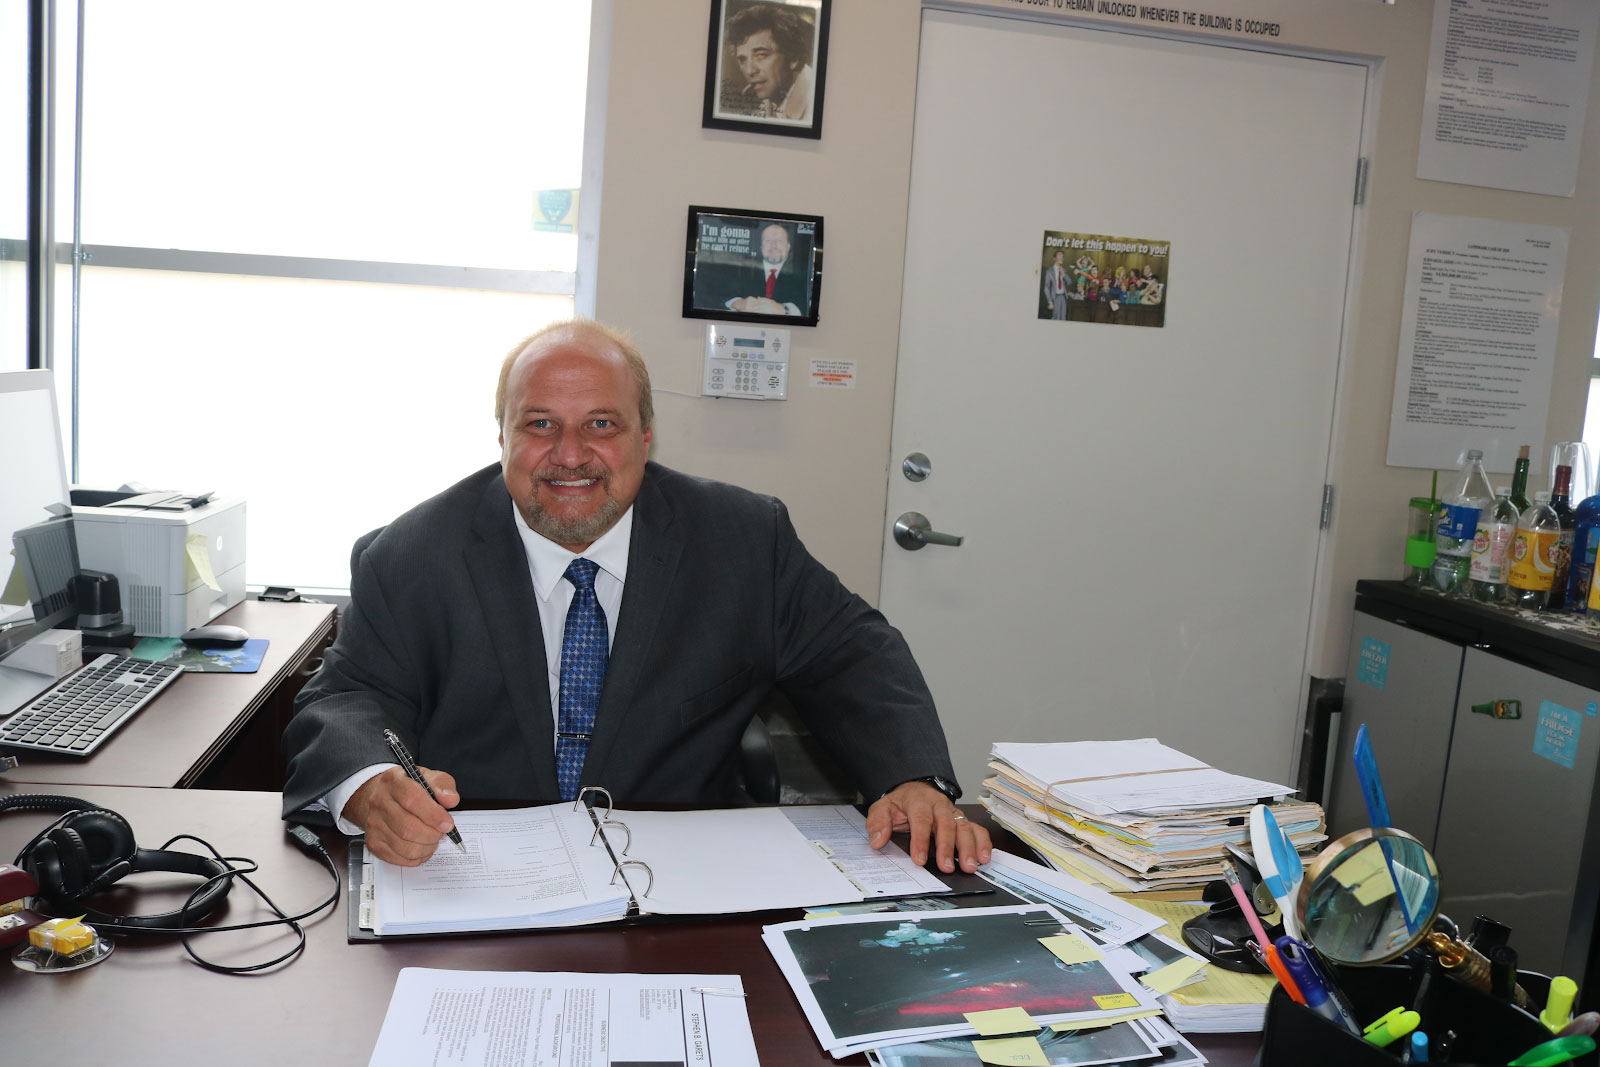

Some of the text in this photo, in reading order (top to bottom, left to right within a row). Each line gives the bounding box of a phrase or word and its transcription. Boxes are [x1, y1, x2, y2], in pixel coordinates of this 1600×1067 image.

[1066, 0, 1094, 12] REMAIN
[1097, 1, 1137, 18] UNLOCKED
[1140, 6, 1179, 23] WHENEVER
[1182, 12, 1196, 26] THE
[1199, 14, 1232, 31] BUILDING
[1235, 20, 1242, 32] IS
[1245, 20, 1281, 37] OCCUPIED
[720, 226, 750, 240] gonna
[701, 242, 750, 254] he can't refuse
[1045, 236, 1169, 256] Don't let this happen to you!
[1540, 717, 1576, 738] FRIDGE
[691, 1013, 701, 1034] STEPHEN
[694, 1040, 704, 1061] GARETS
